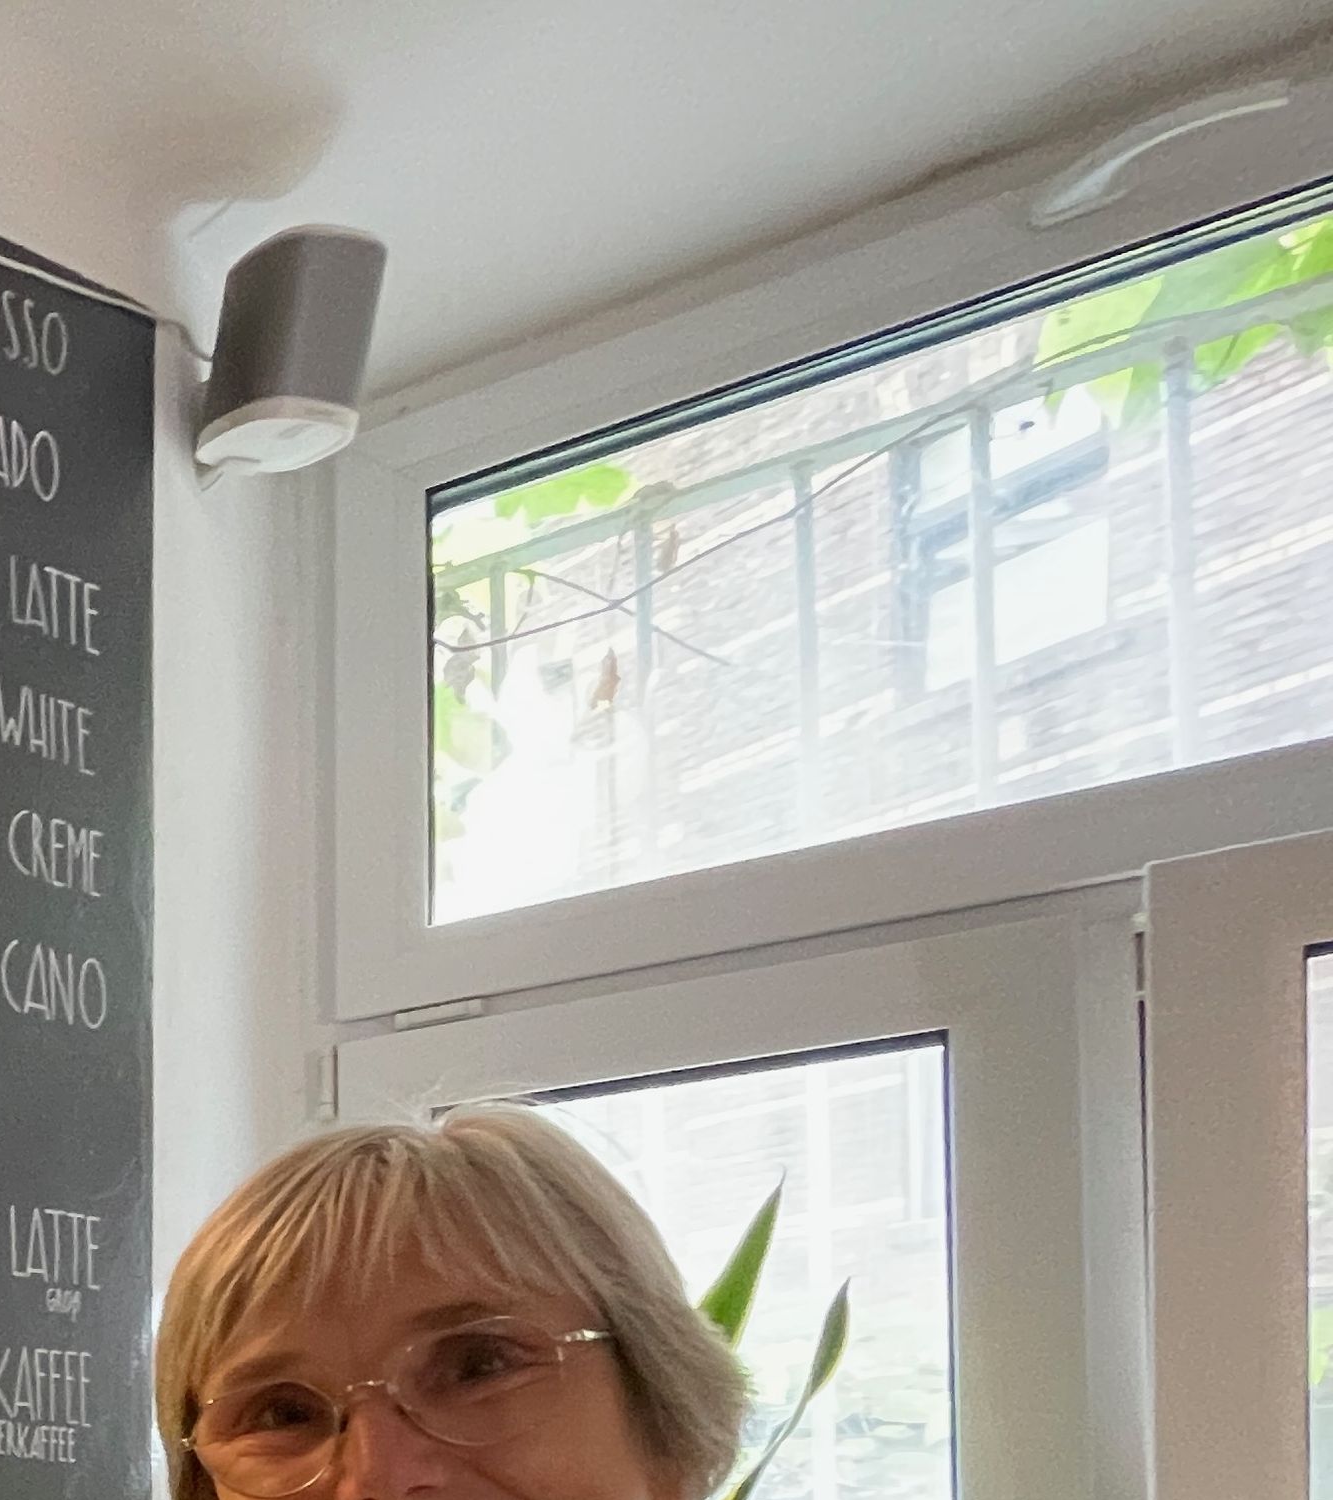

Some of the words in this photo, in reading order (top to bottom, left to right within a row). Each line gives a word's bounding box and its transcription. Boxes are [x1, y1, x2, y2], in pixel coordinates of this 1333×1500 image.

[9, 554, 101, 656] LATTE
[7, 809, 105, 897] CREME
[9, 1204, 101, 1291] LATTE
